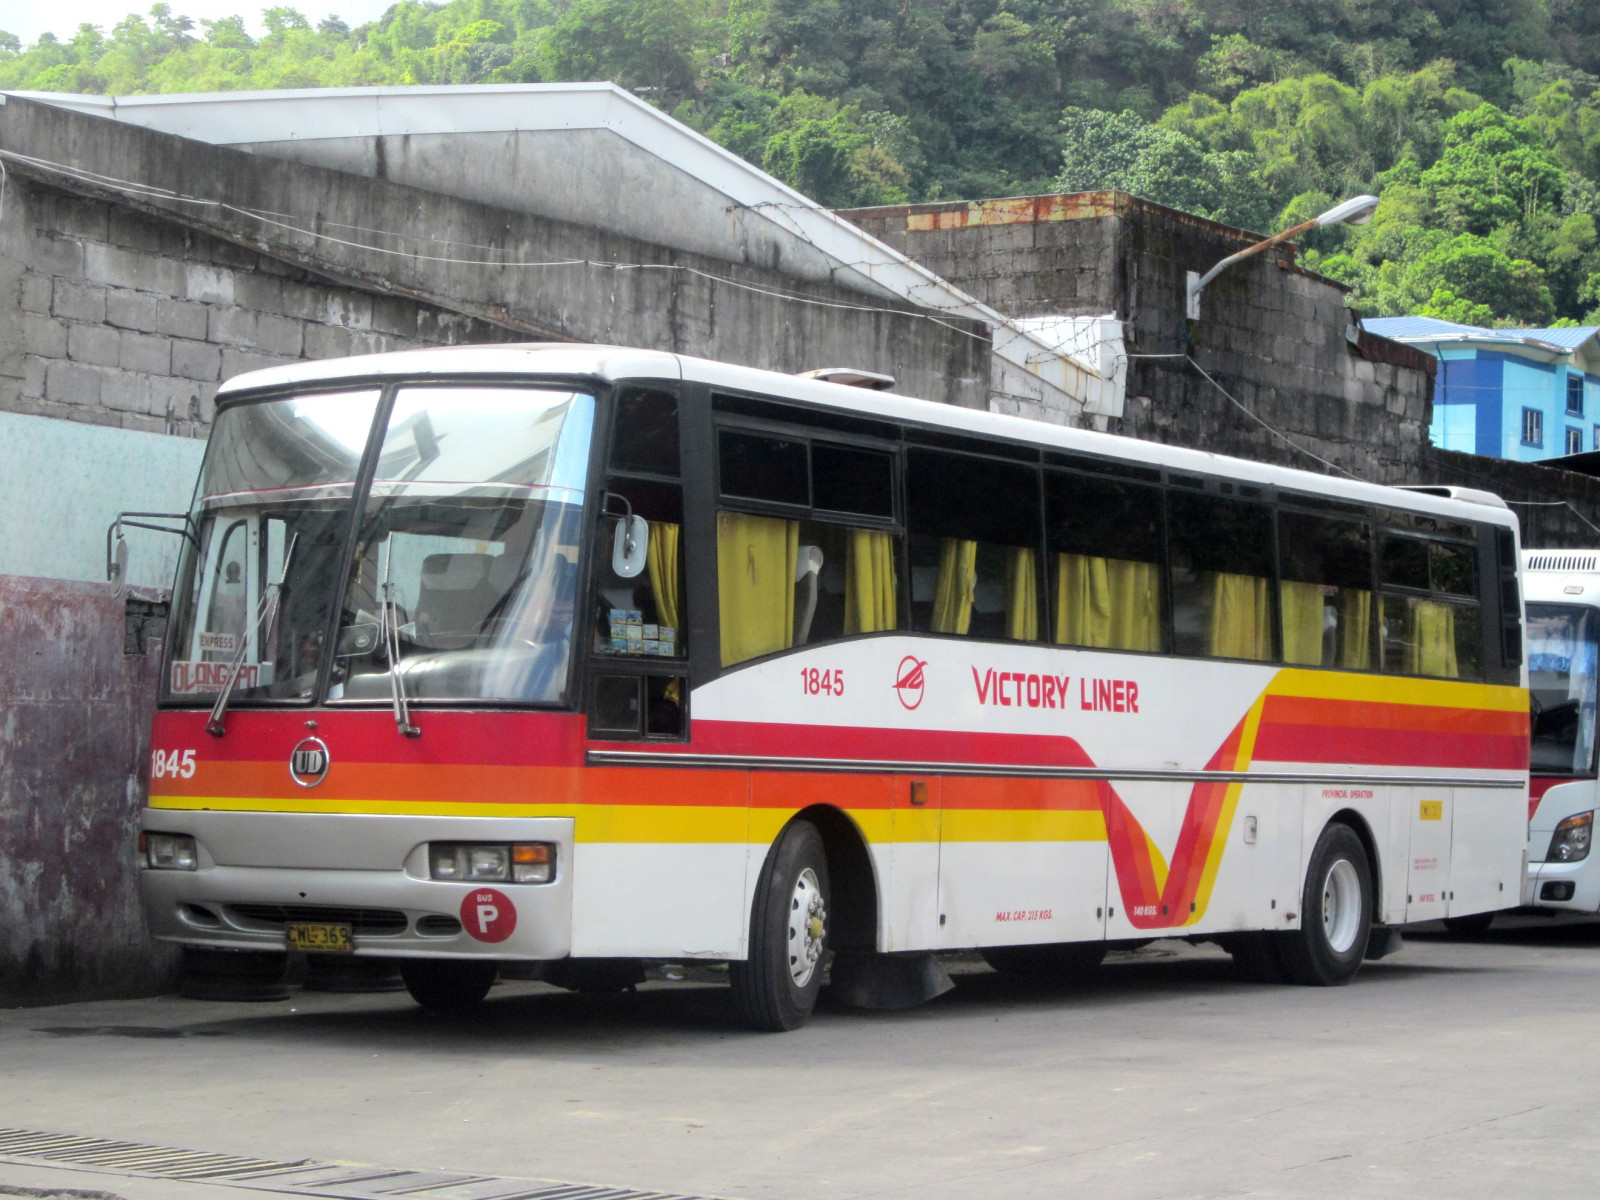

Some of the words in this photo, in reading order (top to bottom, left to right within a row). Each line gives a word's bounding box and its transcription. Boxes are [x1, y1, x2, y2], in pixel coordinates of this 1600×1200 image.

[200, 635, 233, 649] EXPRESS
[801, 667, 844, 696] 1845
[971, 664, 1070, 710] VICTORY
[1080, 677, 1139, 713] LINER
[151, 749, 196, 779] 1845
[296, 750, 323, 773] UD
[476, 894, 493, 902] BUS
[476, 905, 499, 934] P
